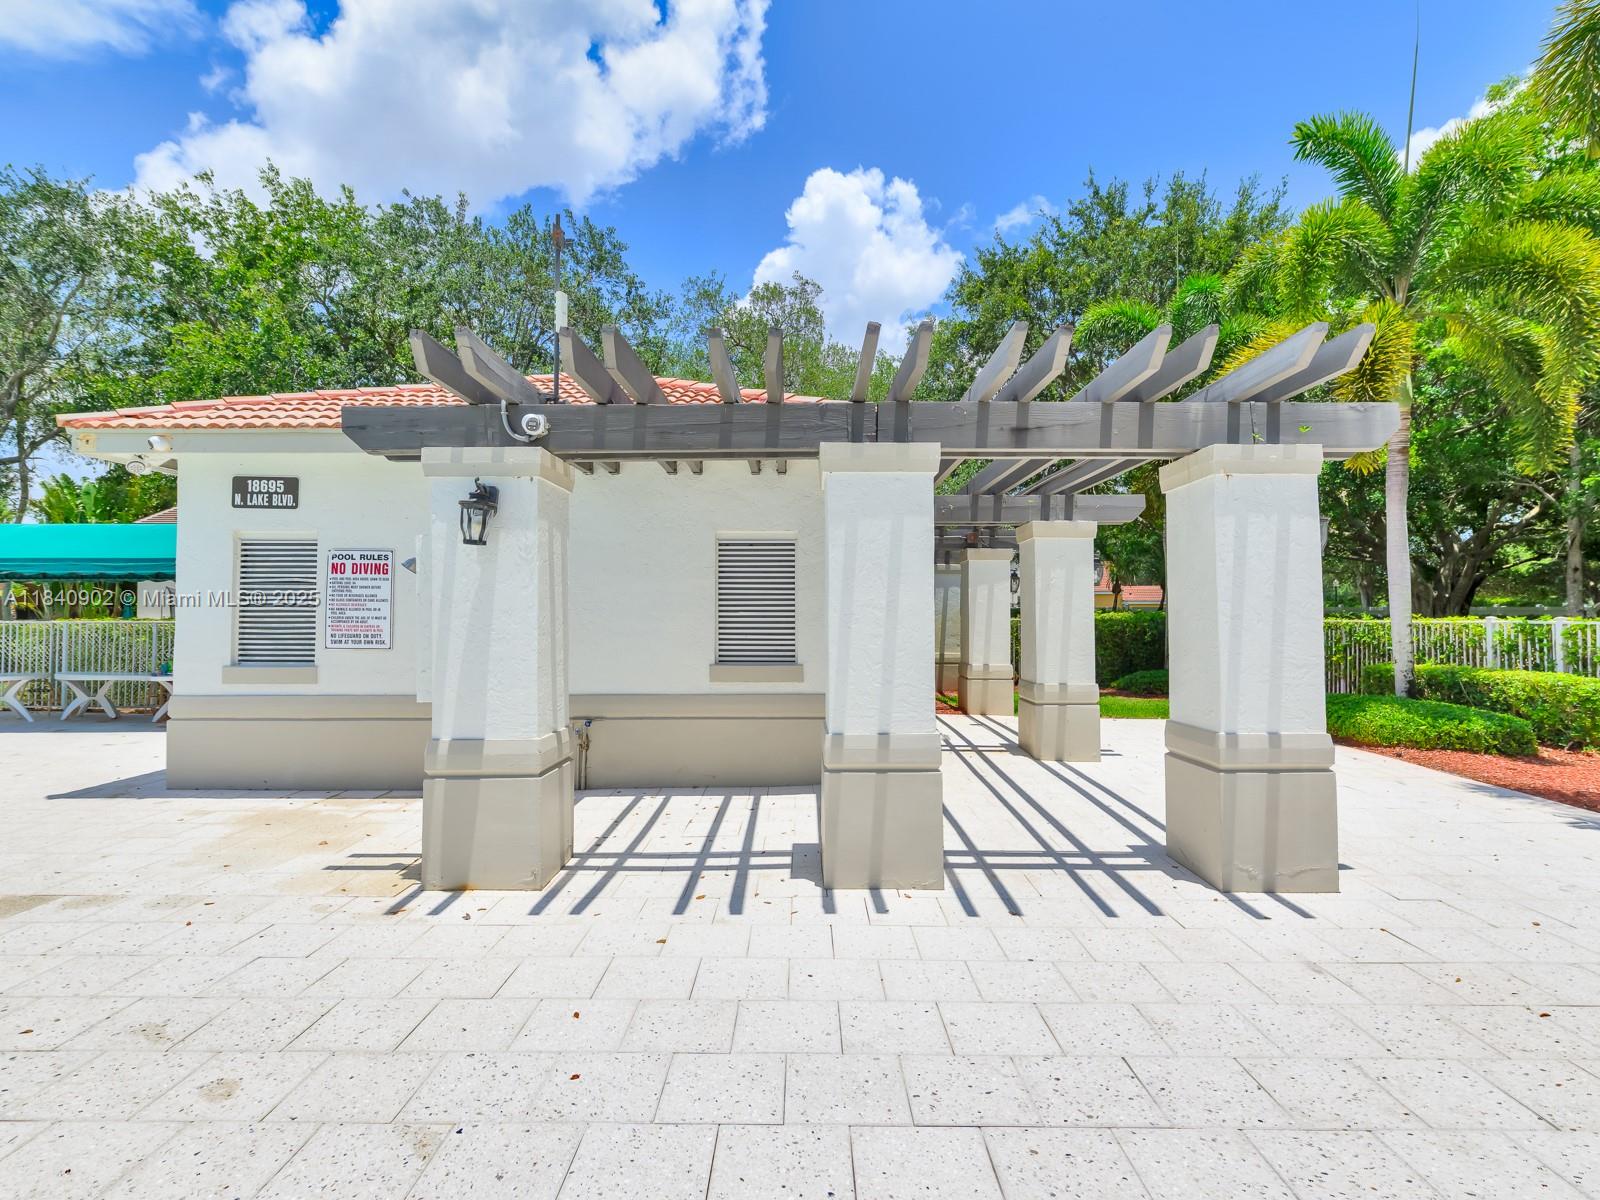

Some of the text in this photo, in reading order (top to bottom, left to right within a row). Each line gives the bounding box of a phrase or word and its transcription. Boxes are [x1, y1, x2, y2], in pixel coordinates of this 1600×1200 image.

[247, 480, 285, 493] 18695
[234, 493, 296, 507] N. LAKE BLVD.
[331, 562, 389, 575] NO DIVING
